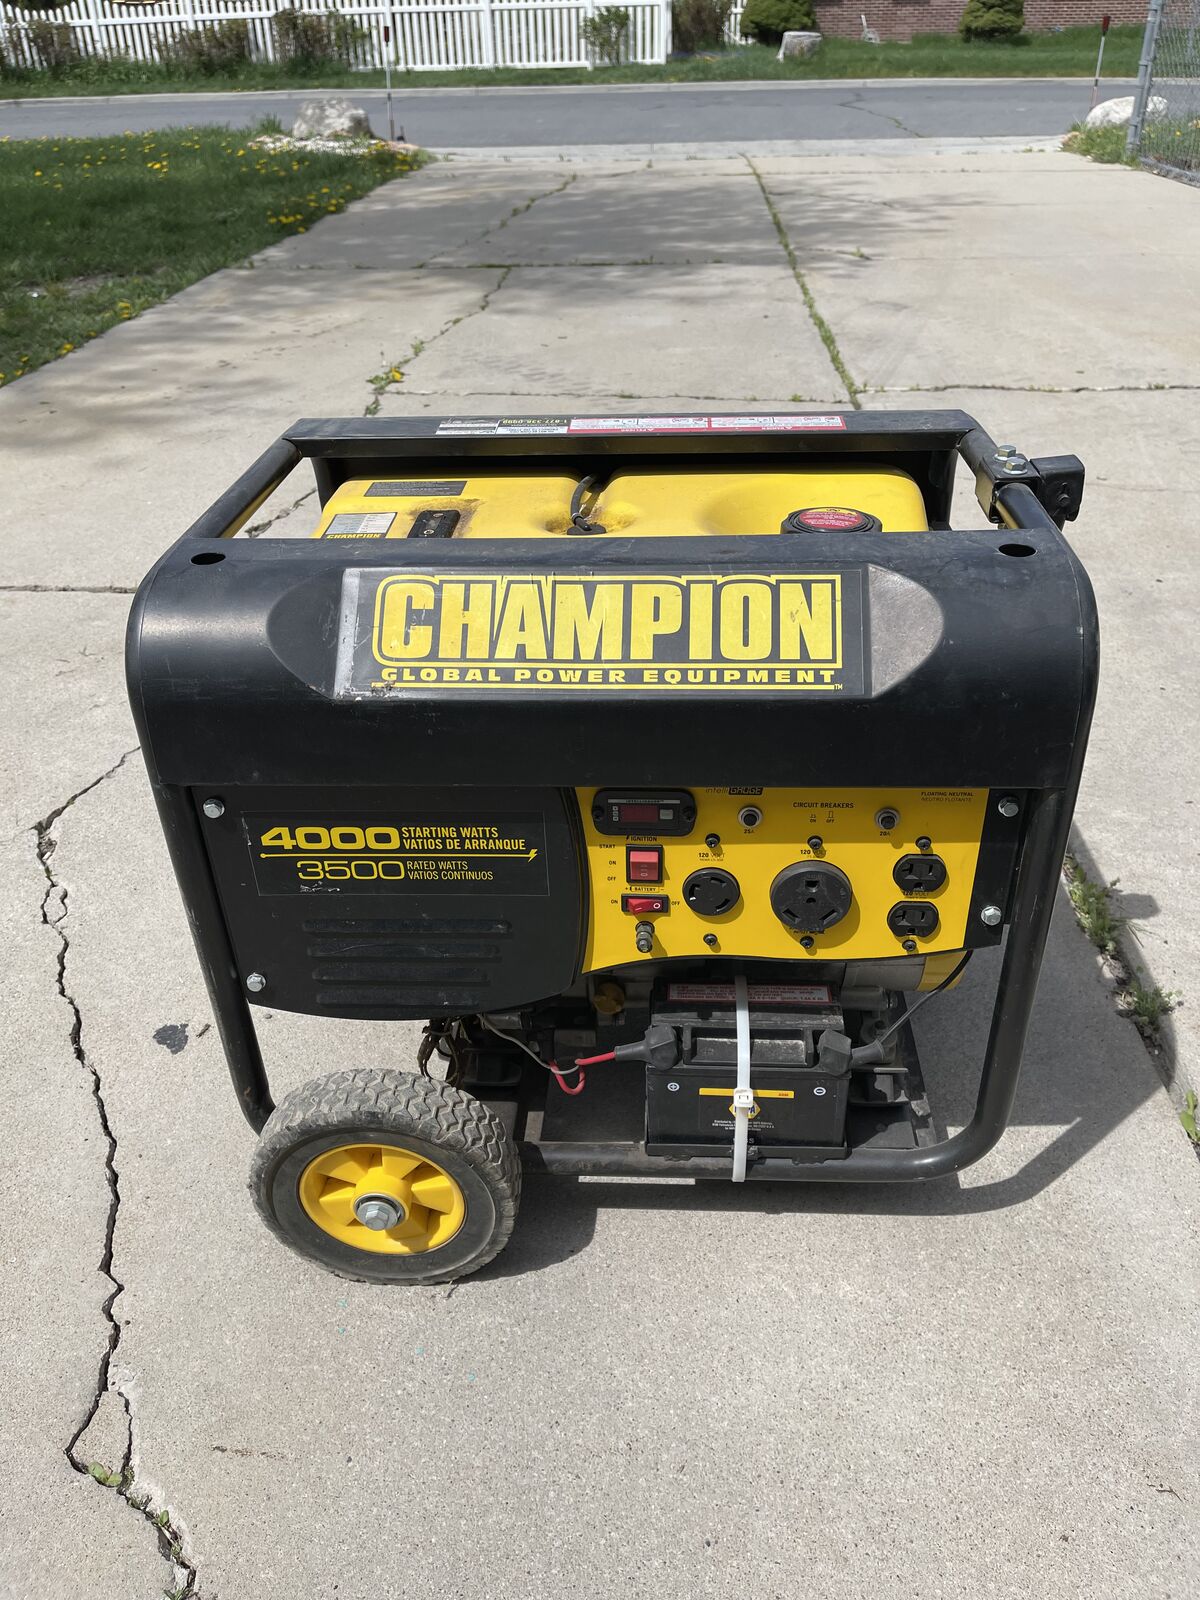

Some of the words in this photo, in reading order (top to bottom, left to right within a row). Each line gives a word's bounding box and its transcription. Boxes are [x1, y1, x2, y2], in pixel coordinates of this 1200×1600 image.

[380, 582, 832, 660] CHAMPION
[381, 667, 501, 682] GLOBAL
[514, 668, 625, 682] POWER
[643, 669, 835, 683] EQUIPMENT
[260, 826, 400, 850] 4000
[401, 827, 457, 838] STARTING
[460, 827, 498, 838] WATTS
[403, 838, 443, 850] VATIOS
[446, 839, 461, 850] DE
[464, 839, 526, 851] ARRANQUE
[297, 860, 405, 880] 3500
[407, 860, 436, 870] RATED
[438, 861, 468, 870] WATTS
[408, 871, 439, 880] VATIOS
[441, 871, 494, 881] CONTINUOS
